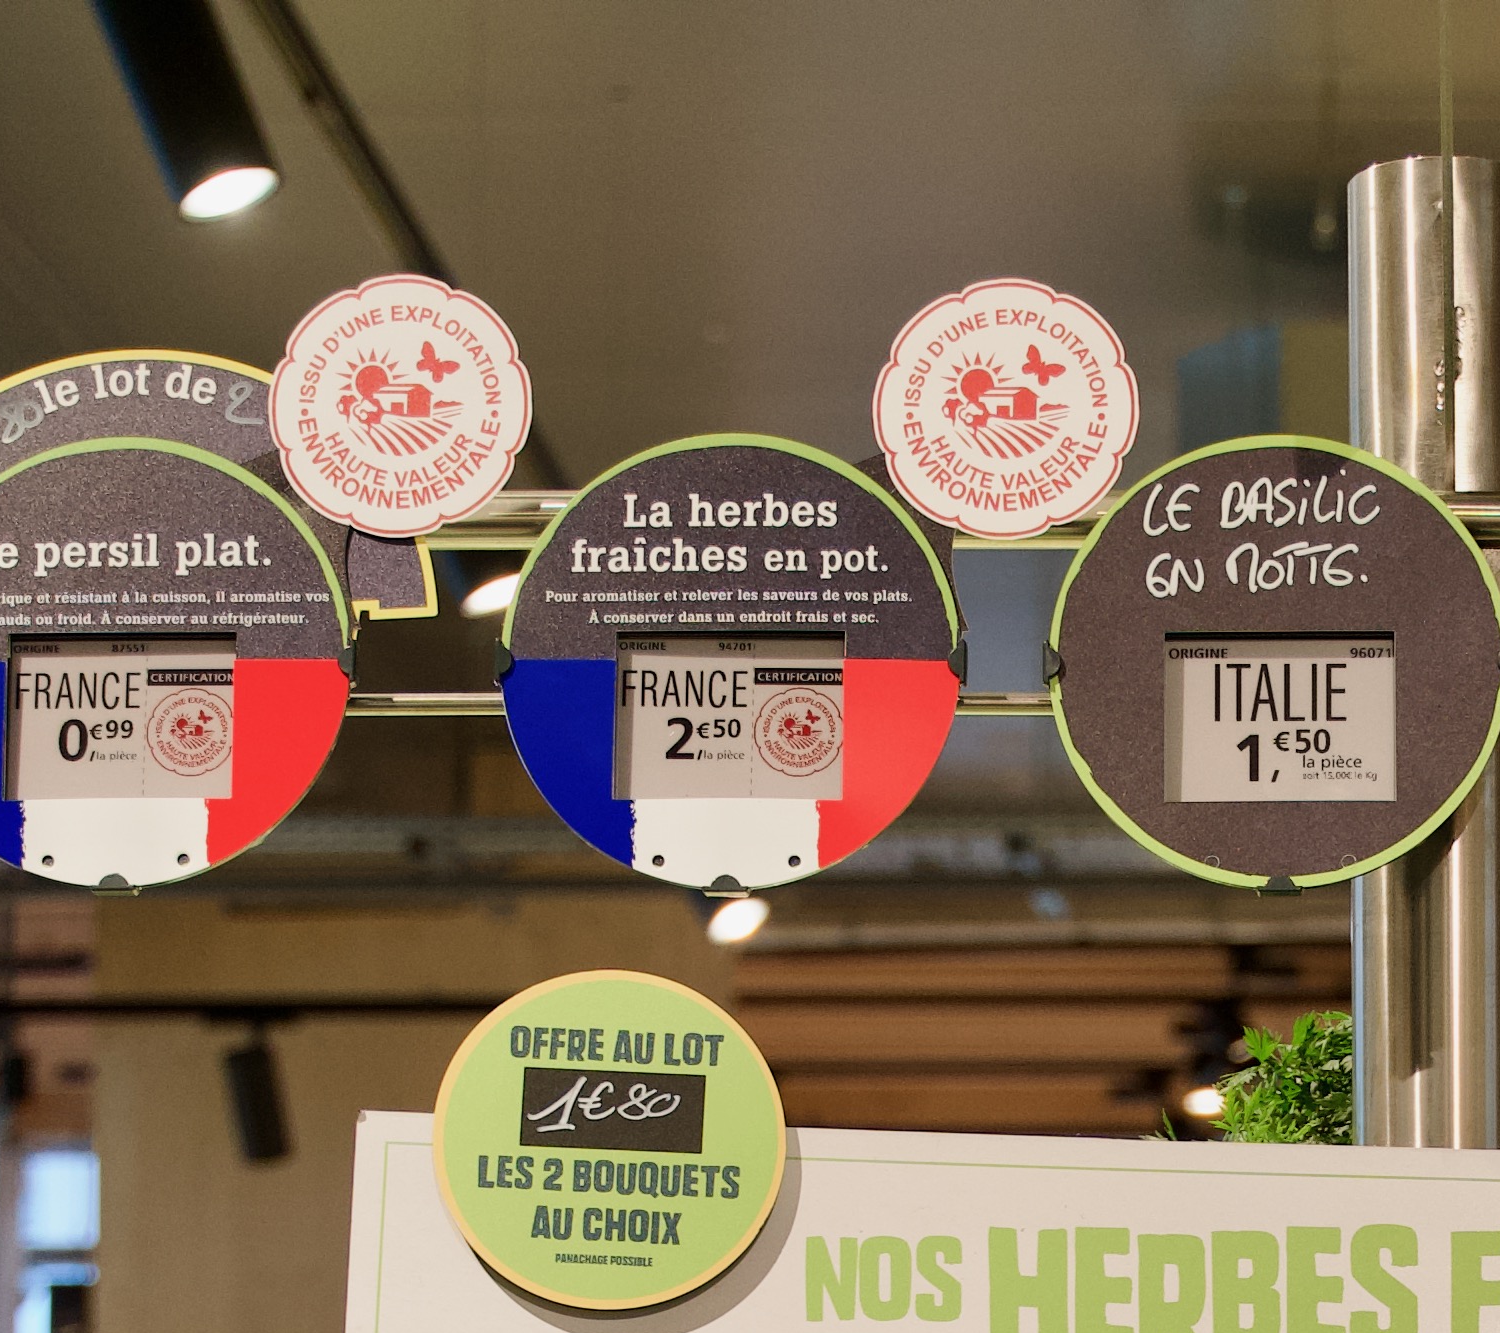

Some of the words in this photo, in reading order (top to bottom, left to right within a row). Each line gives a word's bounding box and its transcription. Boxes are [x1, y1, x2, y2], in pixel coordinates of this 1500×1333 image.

[299, 354, 327, 404] ISSU
[390, 304, 502, 405] EXPLOITATION
[904, 358, 932, 408] ISSU
[995, 309, 1108, 408] EXPLOITATION
[34, 378, 80, 415] le
[90, 363, 151, 400] lot
[165, 364, 218, 405] de
[298, 417, 501, 509] ENVIRONNEMENTALE
[325, 432, 387, 487] HAUTE
[394, 433, 473, 488] VALEUR
[904, 421, 1108, 512] ENVIRONNEMENTALE
[930, 435, 994, 489] HAUTE
[1001, 436, 1080, 490] VALEUR
[623, 495, 673, 528] La
[688, 495, 839, 529] herbes
[1142, 483, 1201, 538] LE
[34, 533, 160, 577] persil
[175, 533, 272, 577] plat.
[570, 537, 748, 574] fraîches
[764, 549, 807, 572] en
[820, 545, 889, 579] pot.
[545, 591, 579, 603] Pour
[582, 589, 660, 603] aromatiser
[664, 591, 678, 602] et
[682, 589, 734, 602] relever
[737, 590, 760, 602] les
[763, 591, 818, 602] saveurs
[822, 589, 840, 602] de
[843, 591, 870, 603] vos
[872, 589, 913, 605] plats.
[604, 613, 675, 624] conserver
[678, 611, 713, 624] dans
[716, 613, 736, 623] un
[739, 610, 792, 623] endroit
[795, 610, 829, 623] frais
[833, 611, 846, 623] et
[850, 612, 880, 625] sec.
[13, 644, 60, 654] ORIGINE
[619, 641, 667, 652] ORIGINE
[1169, 649, 1228, 659] ORIGINE
[1350, 648, 1392, 658] 96071
[15, 671, 141, 710] FRANCE
[150, 672, 233, 684] CERTIFICATION
[620, 669, 748, 708] FRANCE
[757, 671, 842, 683] CERTIFICATION
[1214, 663, 1347, 722] ITALIE
[1302, 755, 1315, 768] la
[1321, 755, 1362, 771] pièce
[510, 1025, 605, 1062] OFFRE
[613, 1029, 656, 1064] AU
[664, 1033, 724, 1067] LOT
[477, 1155, 535, 1189] LES
[543, 1158, 563, 1190] 2
[573, 1160, 741, 1199] BOUQUETS
[531, 1205, 573, 1240] AU
[582, 1208, 682, 1245] CHOIX
[555, 1253, 608, 1265] PANACHAGE
[610, 1256, 653, 1267] POSSIBLE
[805, 1235, 962, 1322] NOS
